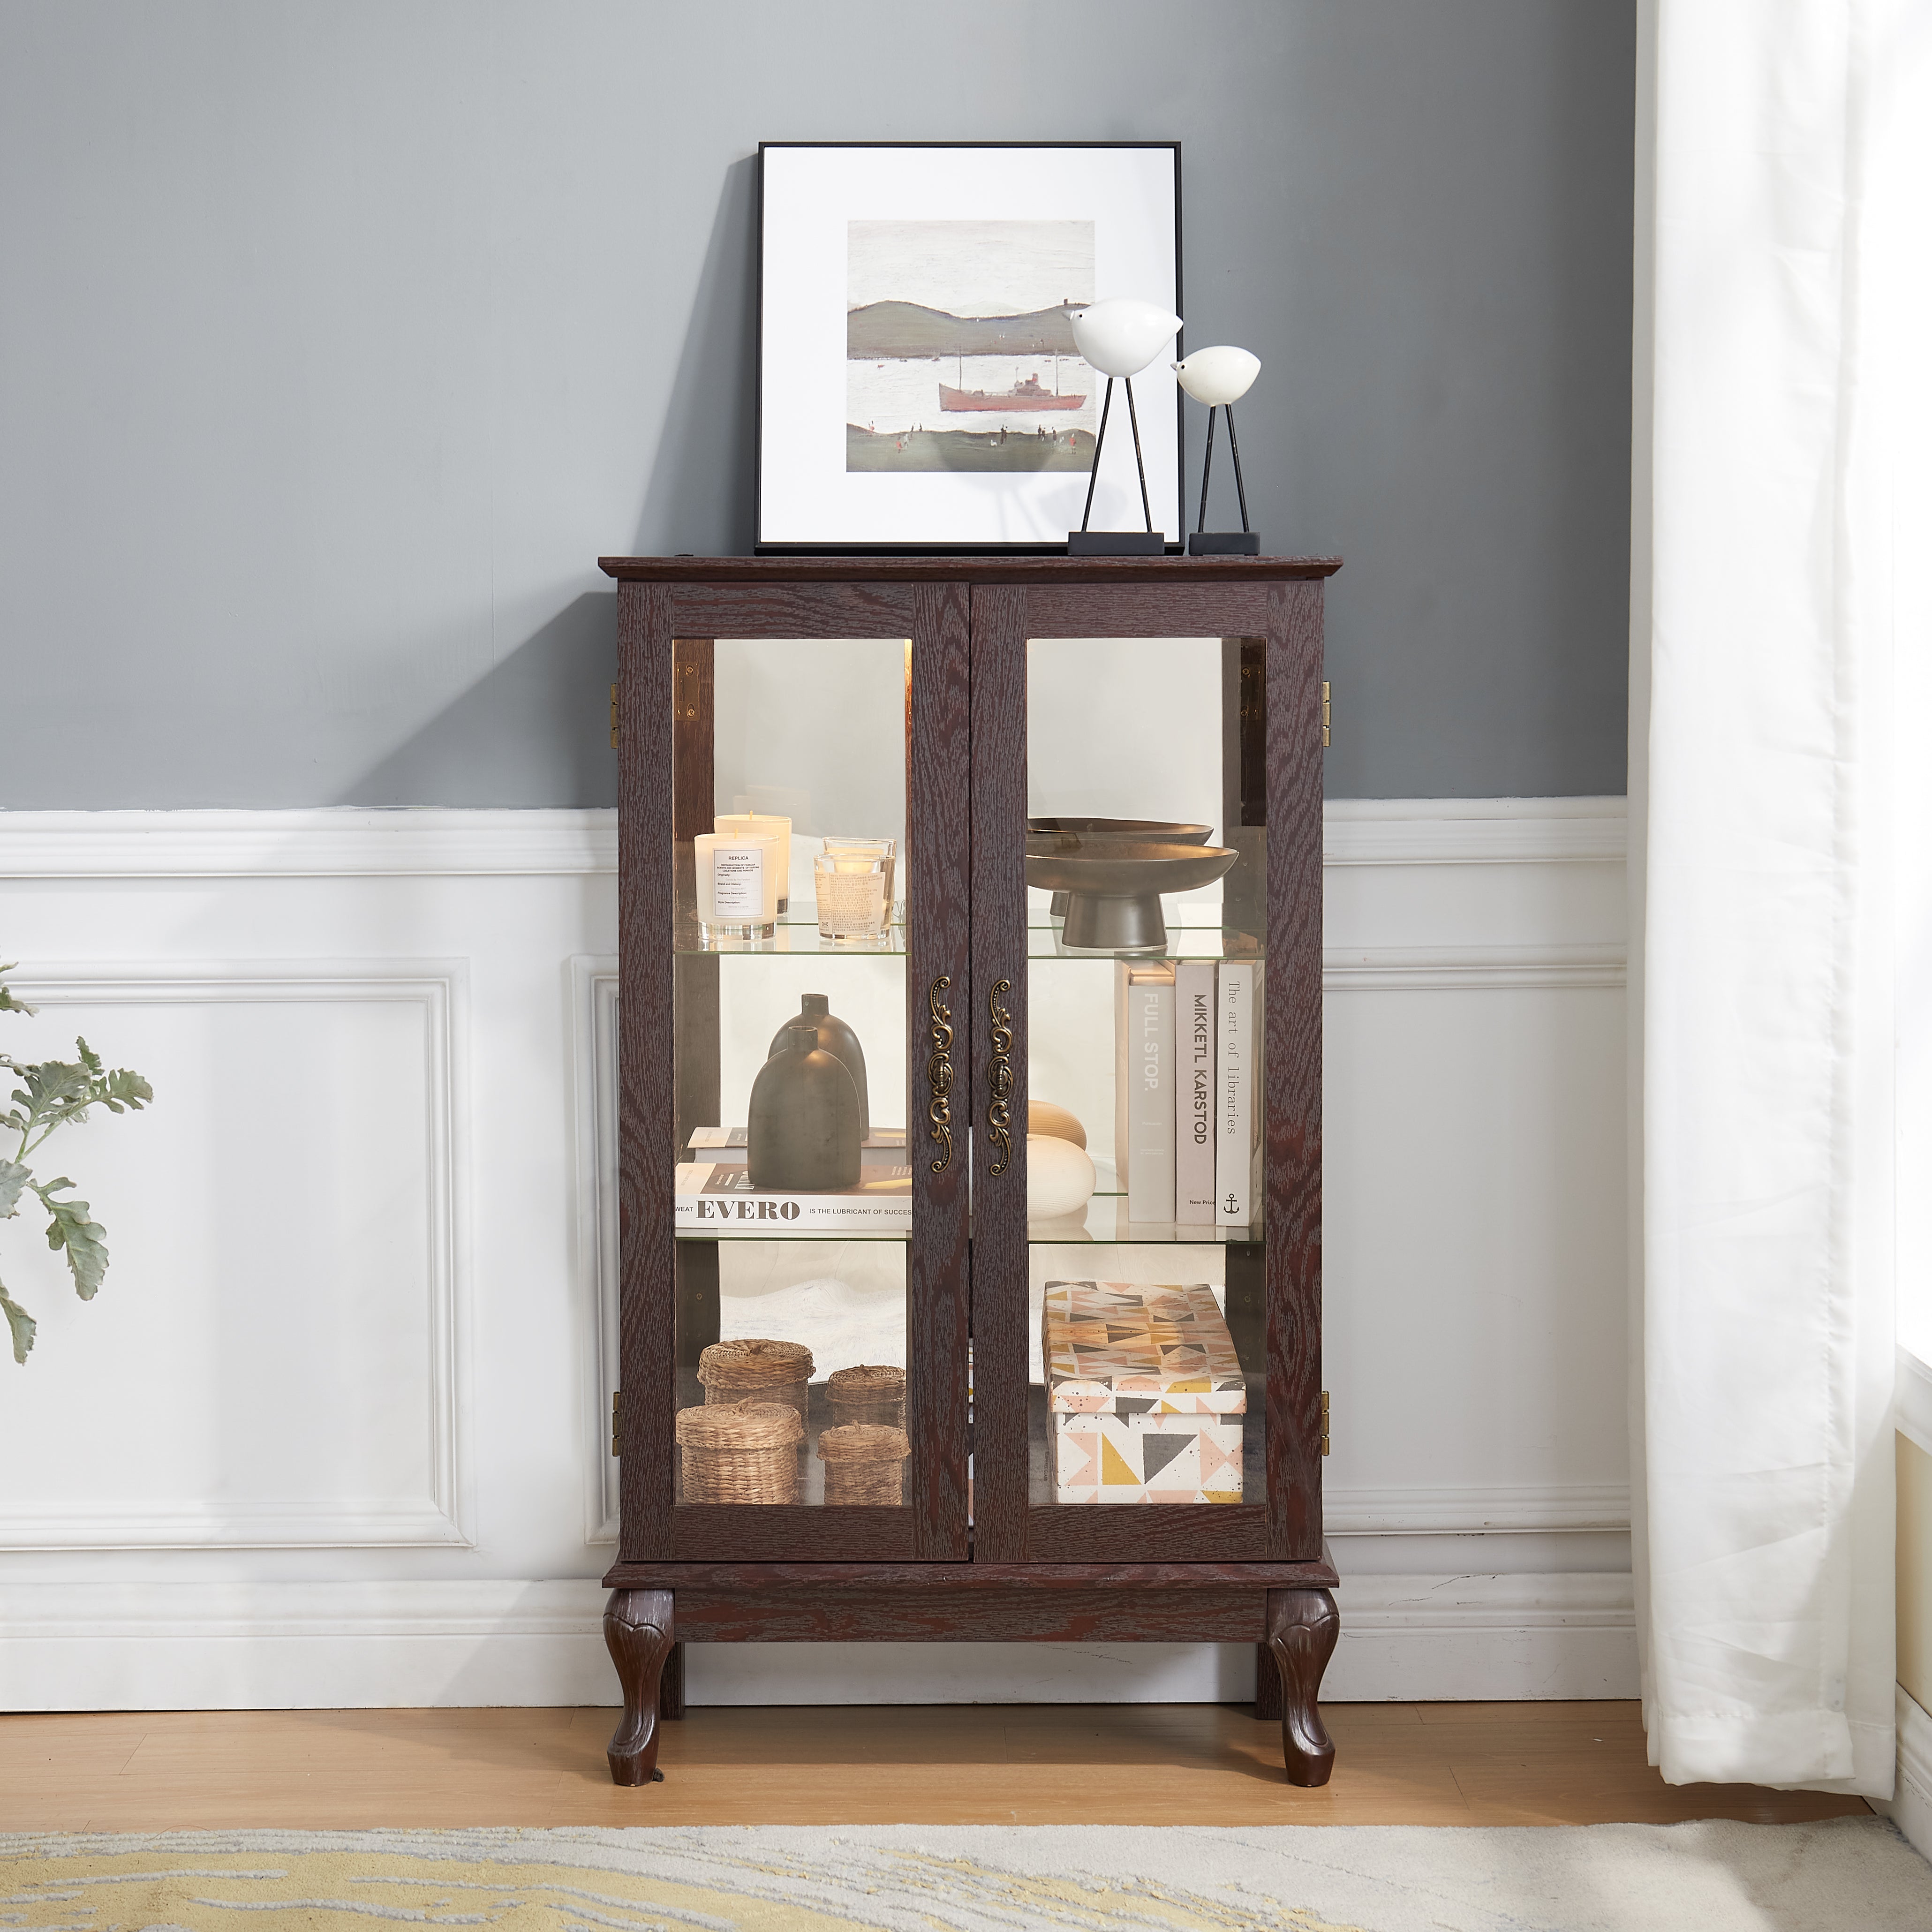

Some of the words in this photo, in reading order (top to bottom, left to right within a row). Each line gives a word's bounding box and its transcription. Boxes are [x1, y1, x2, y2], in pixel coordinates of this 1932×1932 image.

[1229, 981, 1240, 1004] The
[1145, 994, 1158, 1037] FULL
[1194, 995, 1207, 1063] MIKKETL
[1228, 1011, 1238, 1034] art
[1145, 1042, 1158, 1091] STOP.
[1228, 1042, 1239, 1058] of
[1194, 1070, 1207, 1144] KARSTOD
[1227, 1067, 1239, 1134] libraries
[696, 1200, 800, 1220] EVERO
